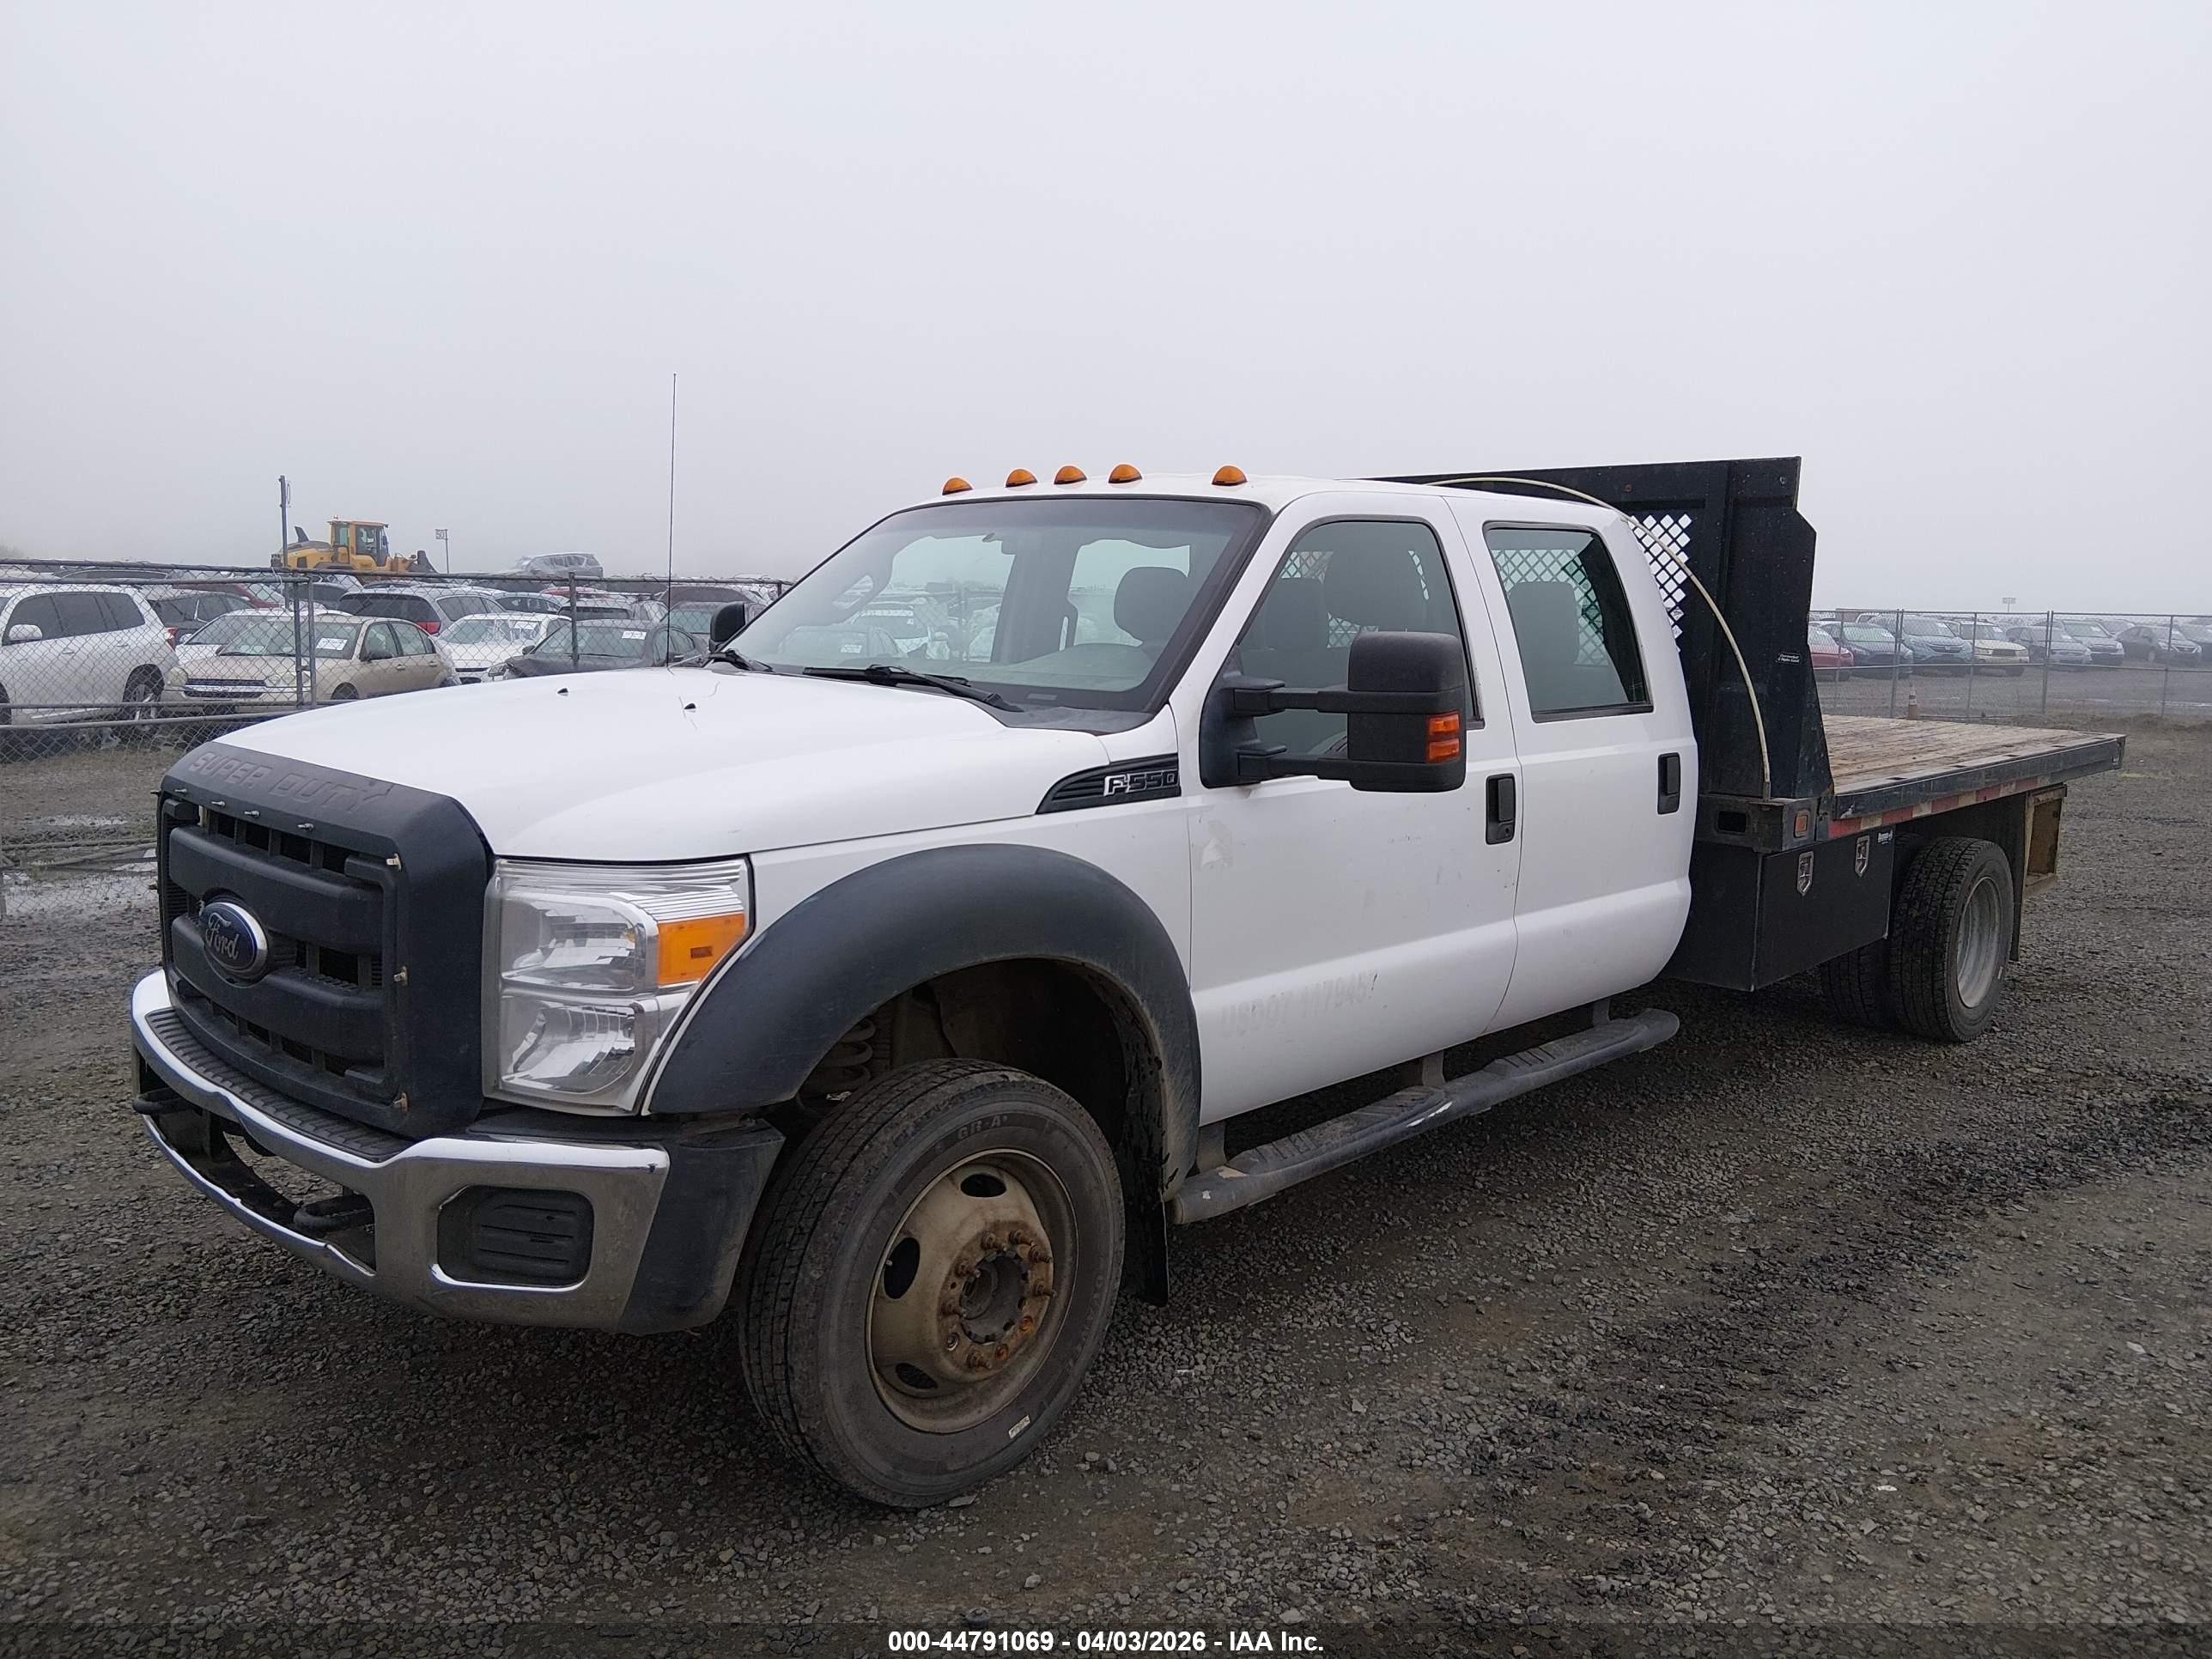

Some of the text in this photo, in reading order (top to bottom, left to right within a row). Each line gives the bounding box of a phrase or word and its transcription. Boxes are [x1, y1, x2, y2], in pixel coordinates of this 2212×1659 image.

[188, 751, 395, 813] SUPER DUTY
[206, 912, 240, 960] Ford
